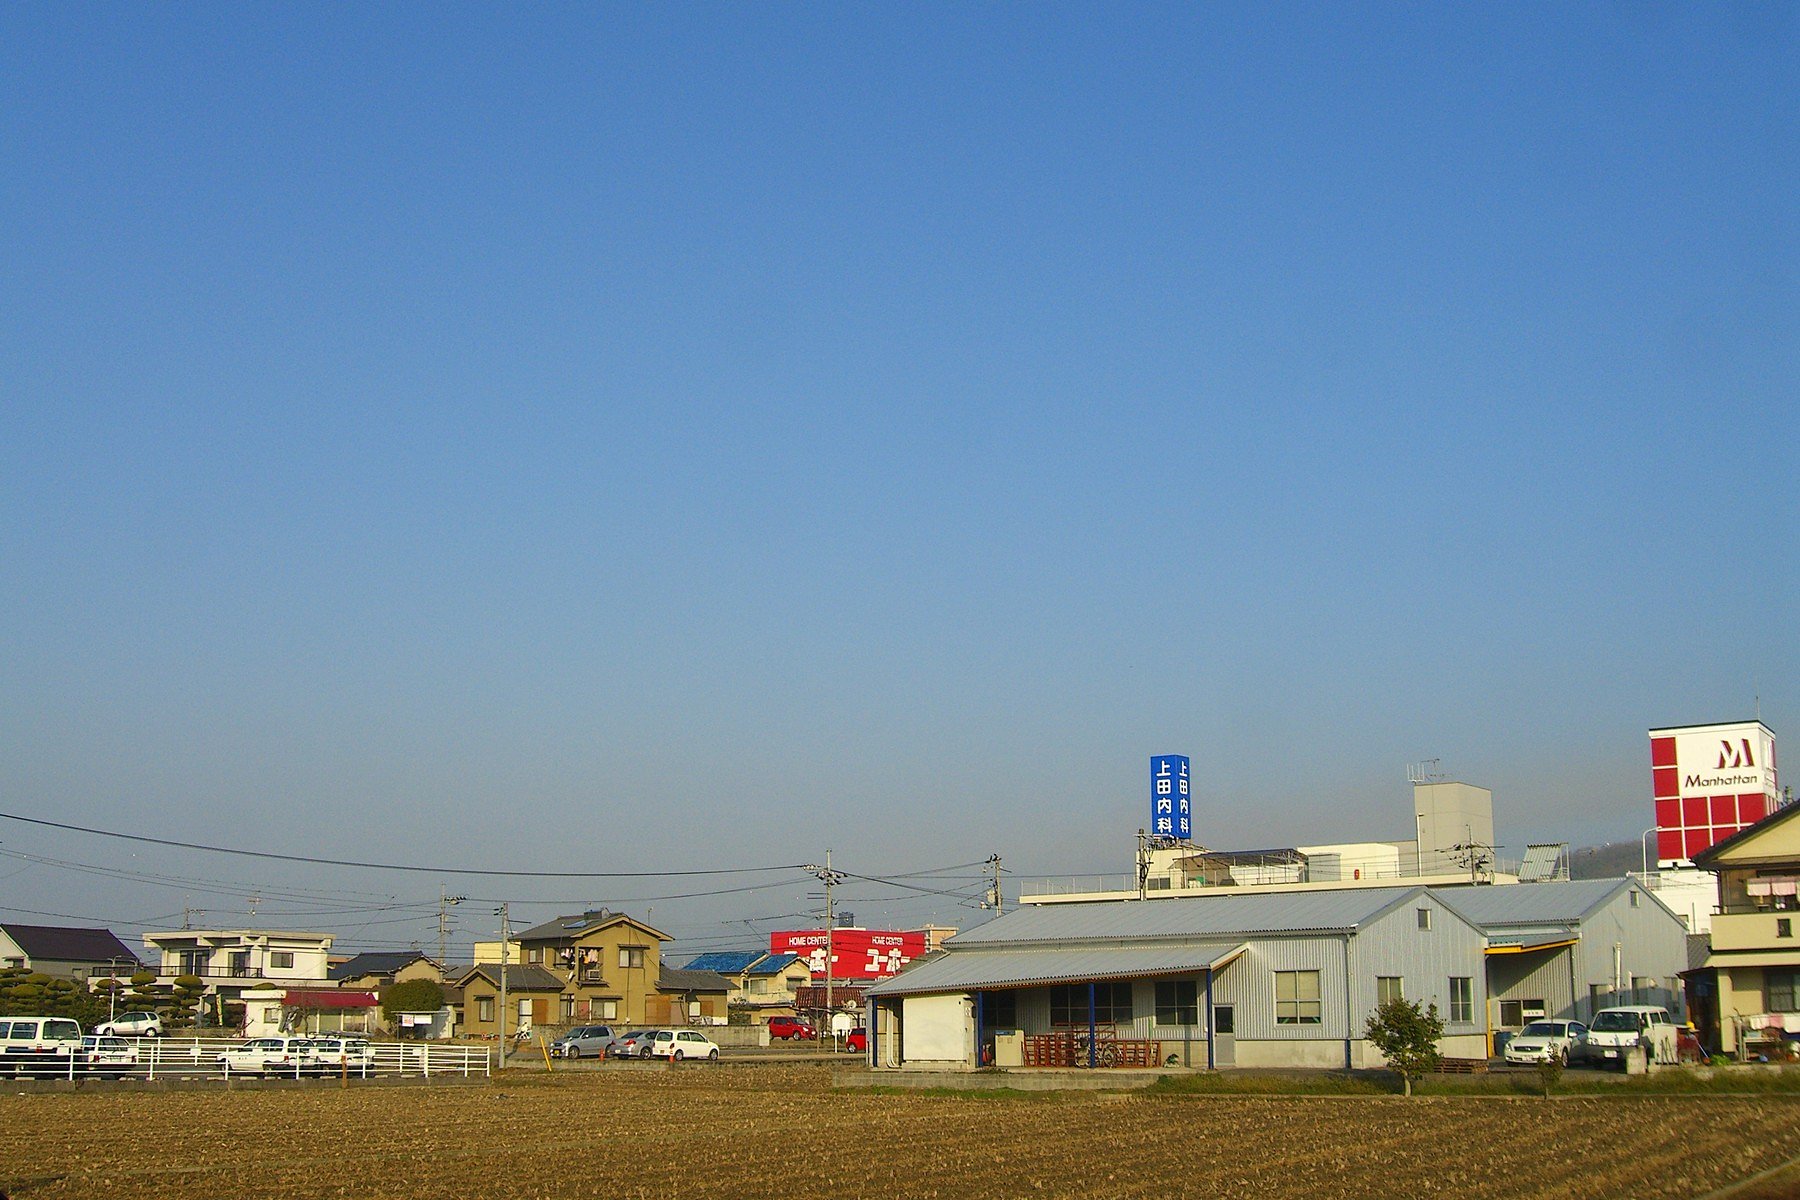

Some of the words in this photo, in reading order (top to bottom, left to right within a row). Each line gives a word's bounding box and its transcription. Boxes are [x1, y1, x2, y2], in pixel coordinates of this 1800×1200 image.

[1685, 774, 1758, 788] Manhattan
[1156, 760, 1172, 833] 上田内科
[1179, 760, 1188, 833] 上田内科
[788, 936, 806, 946] HOME
[807, 936, 828, 946] CENTE
[872, 936, 886, 945] HOME
[886, 936, 903, 946] CENTER
